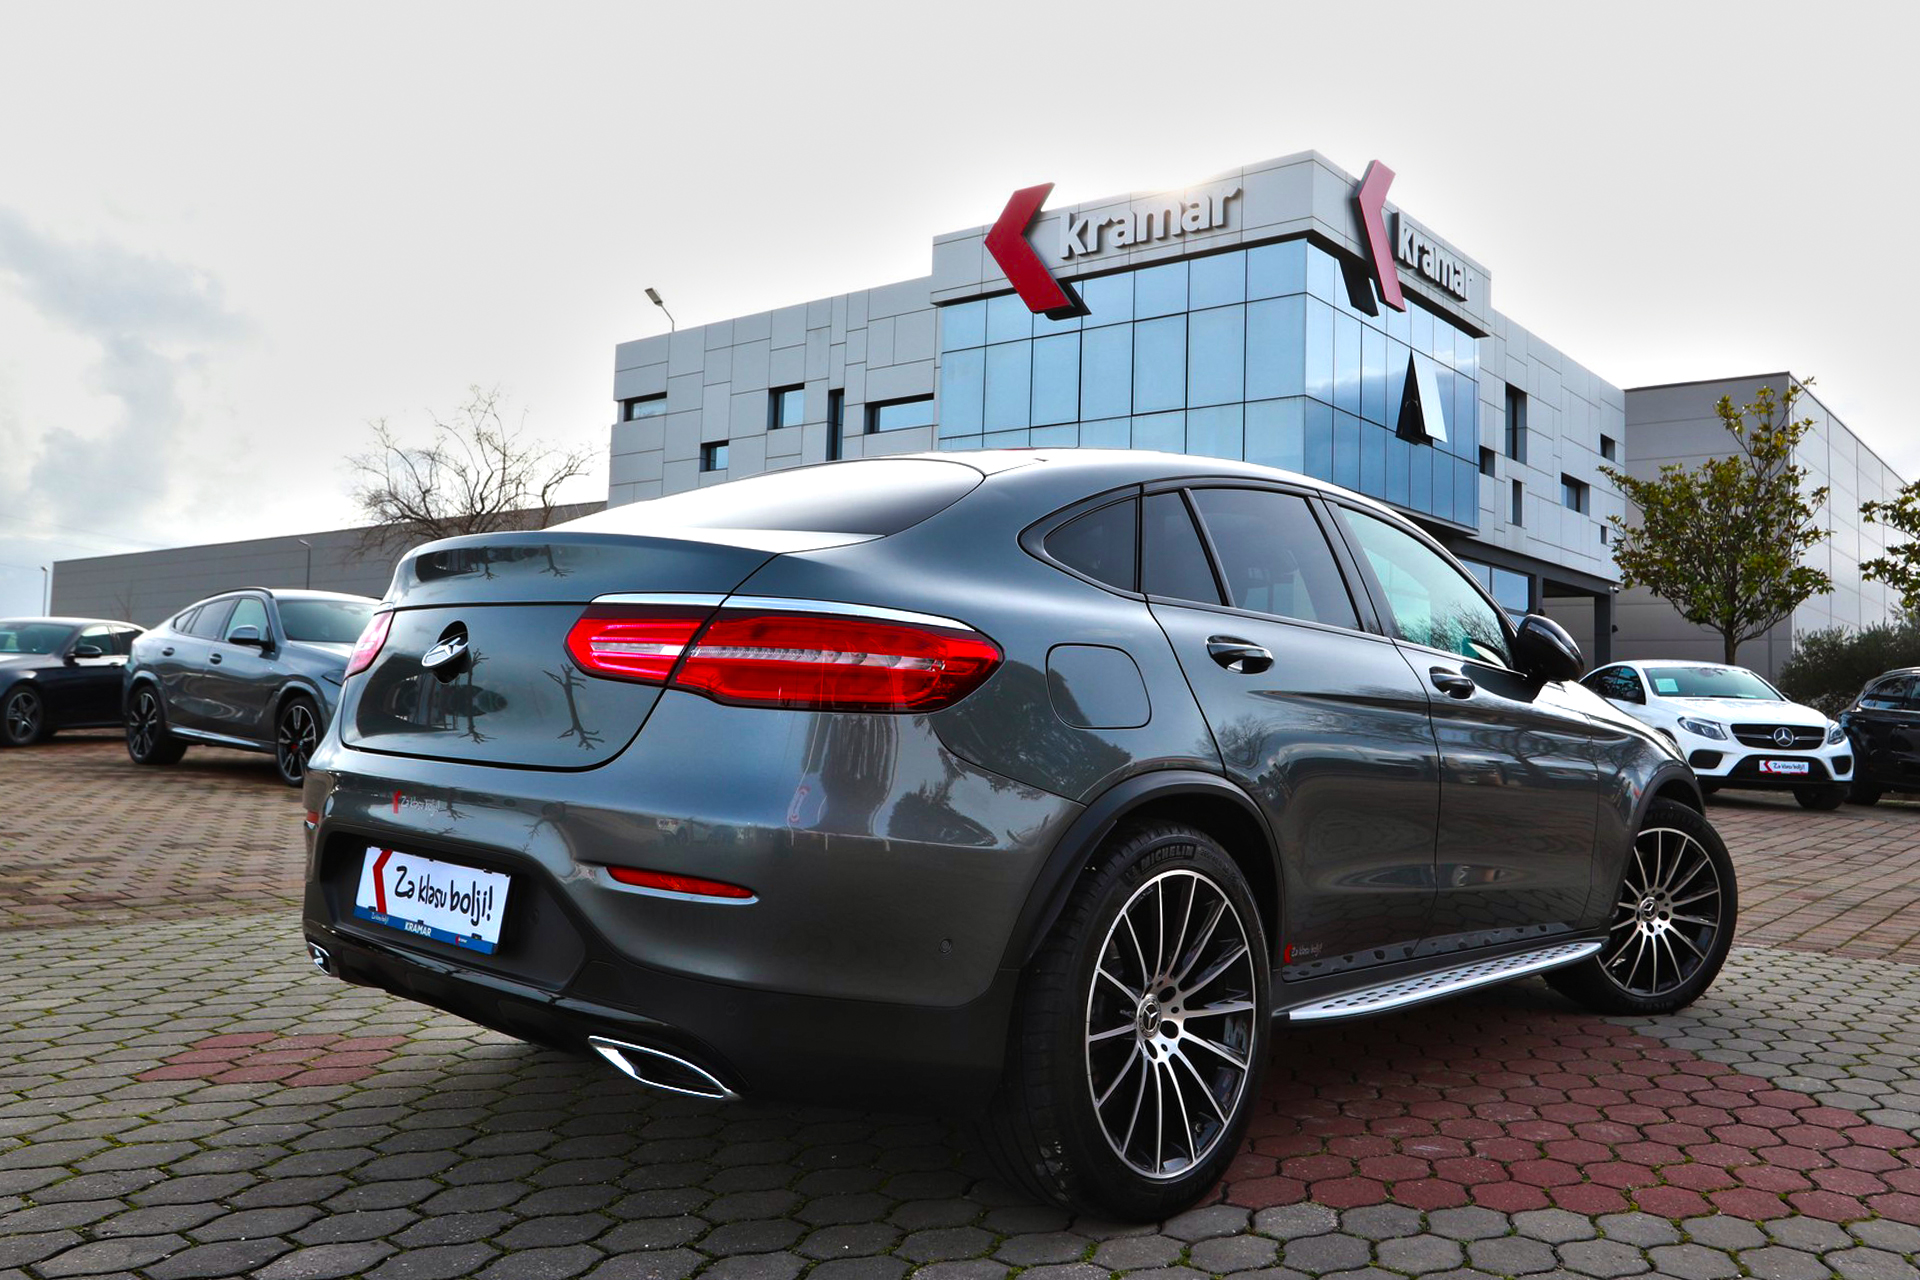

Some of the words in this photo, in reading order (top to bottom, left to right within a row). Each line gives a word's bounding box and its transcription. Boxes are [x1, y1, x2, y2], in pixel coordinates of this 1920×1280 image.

[1058, 186, 1243, 260] kramar
[1141, 845, 1194, 870] MICHELIN
[394, 865, 415, 899] Za
[417, 873, 447, 909] klasu
[449, 879, 493, 927] bolji!
[404, 921, 432, 937] KRAMAR
